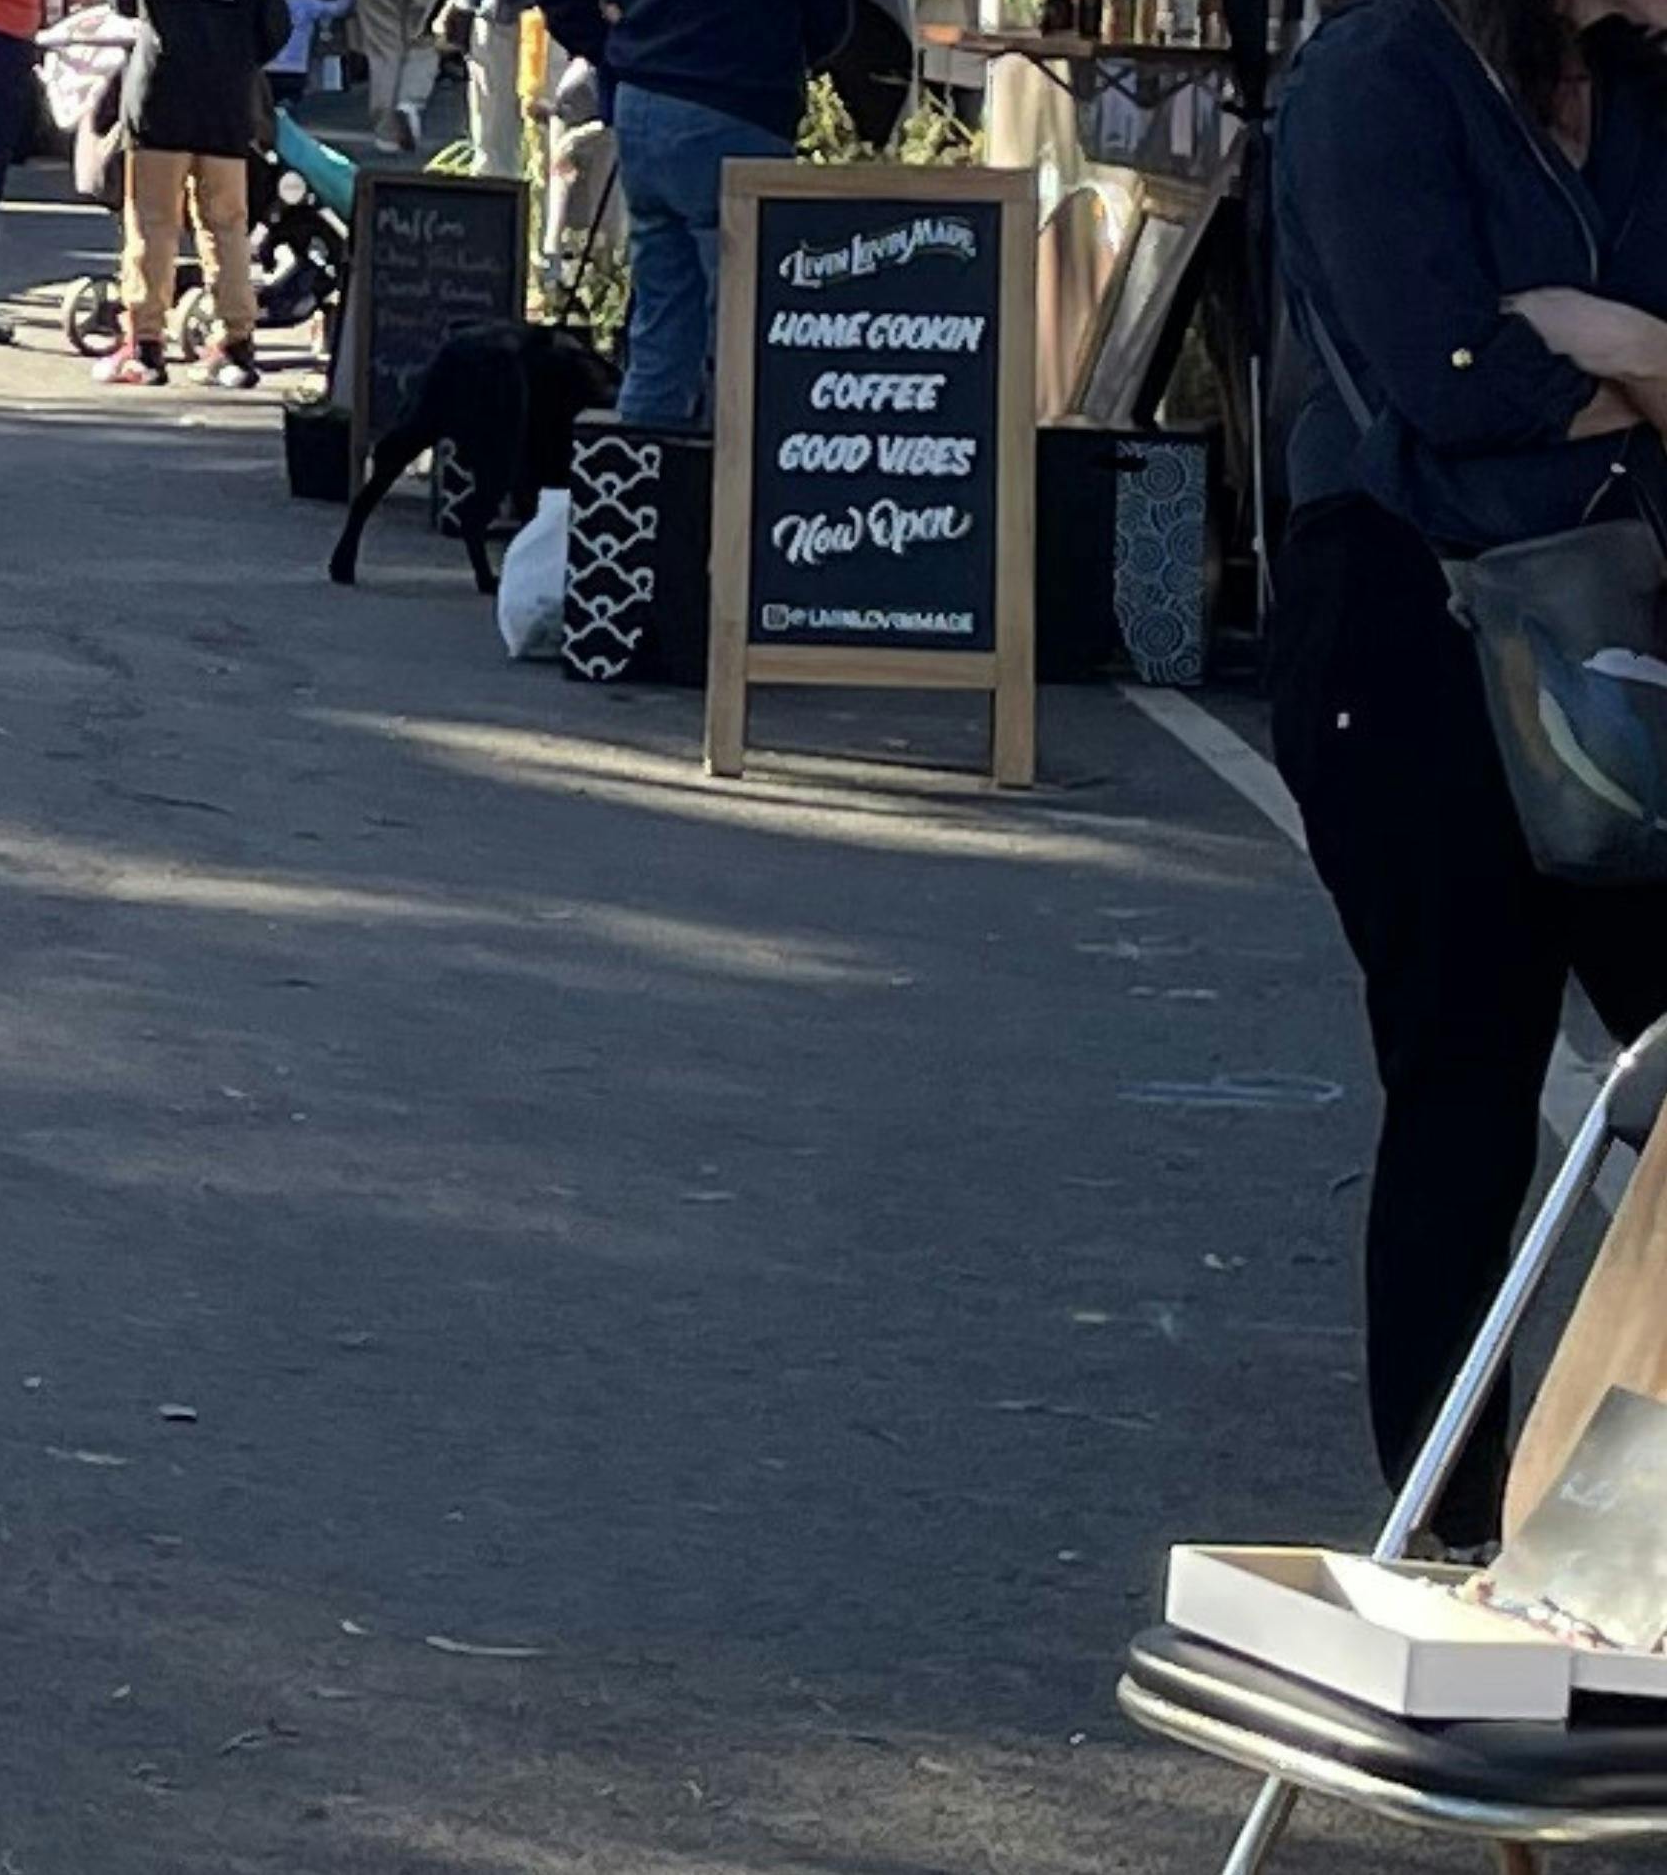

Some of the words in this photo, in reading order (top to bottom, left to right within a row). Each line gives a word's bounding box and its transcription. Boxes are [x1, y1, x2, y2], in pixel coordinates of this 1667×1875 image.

[768, 311, 870, 347] HOME
[866, 313, 985, 352] COOKIN
[810, 371, 947, 412] COFFEE
[778, 432, 873, 472] GOOD
[876, 433, 977, 476] VIBES
[772, 505, 865, 564] Now
[867, 497, 973, 555] Open
